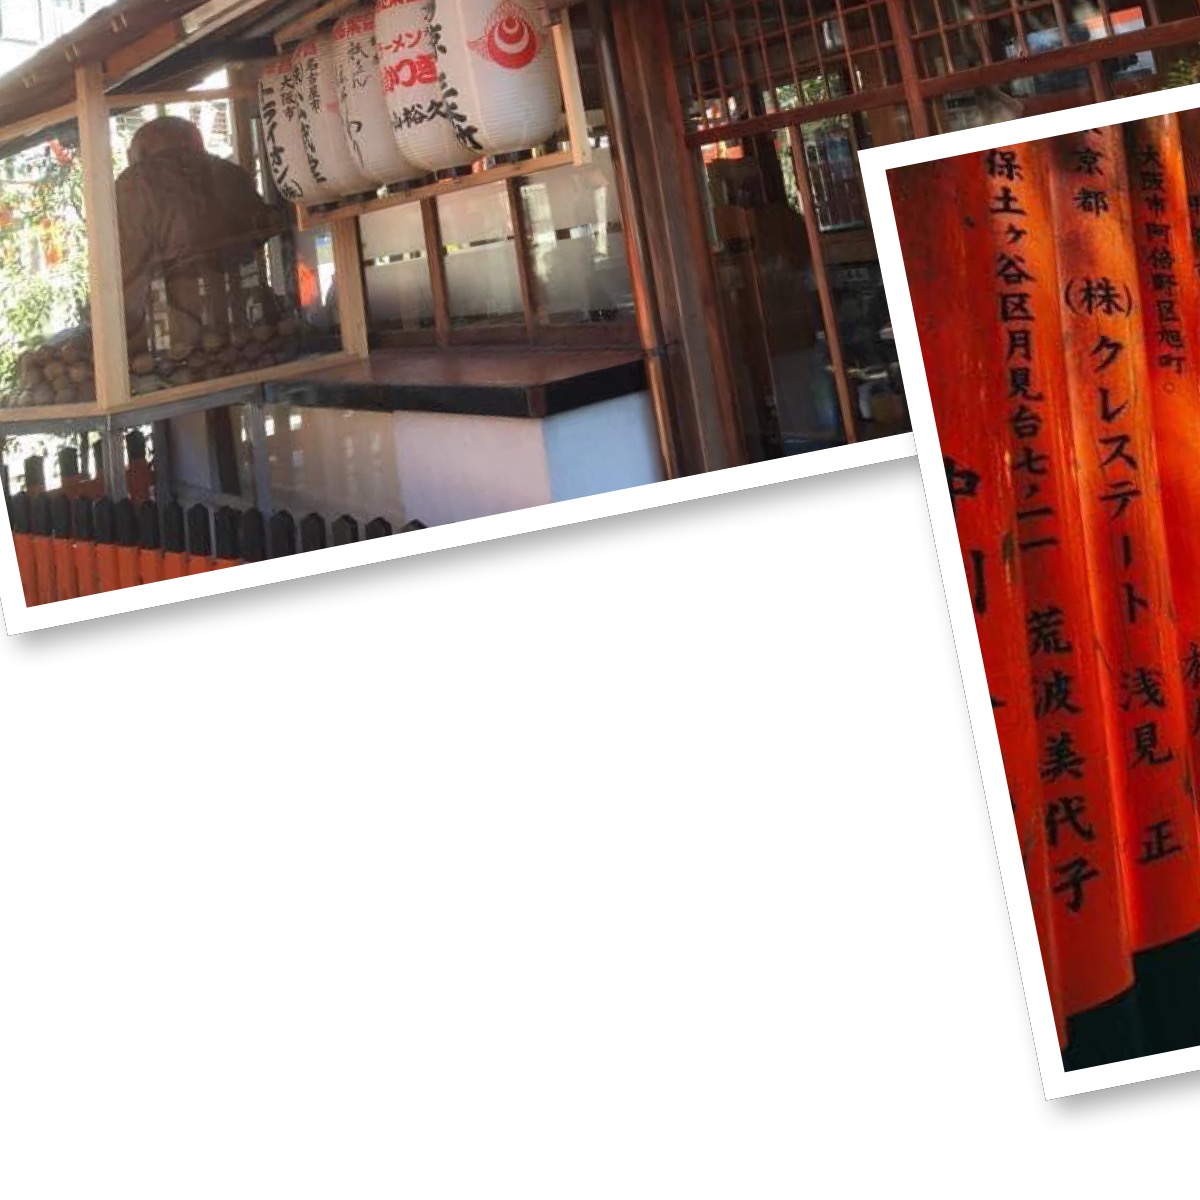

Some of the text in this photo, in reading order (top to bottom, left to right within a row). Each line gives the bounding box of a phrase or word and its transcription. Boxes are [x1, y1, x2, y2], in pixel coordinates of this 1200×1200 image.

[1064, 276, 1183, 864] (株)クレステート 浅見 正
